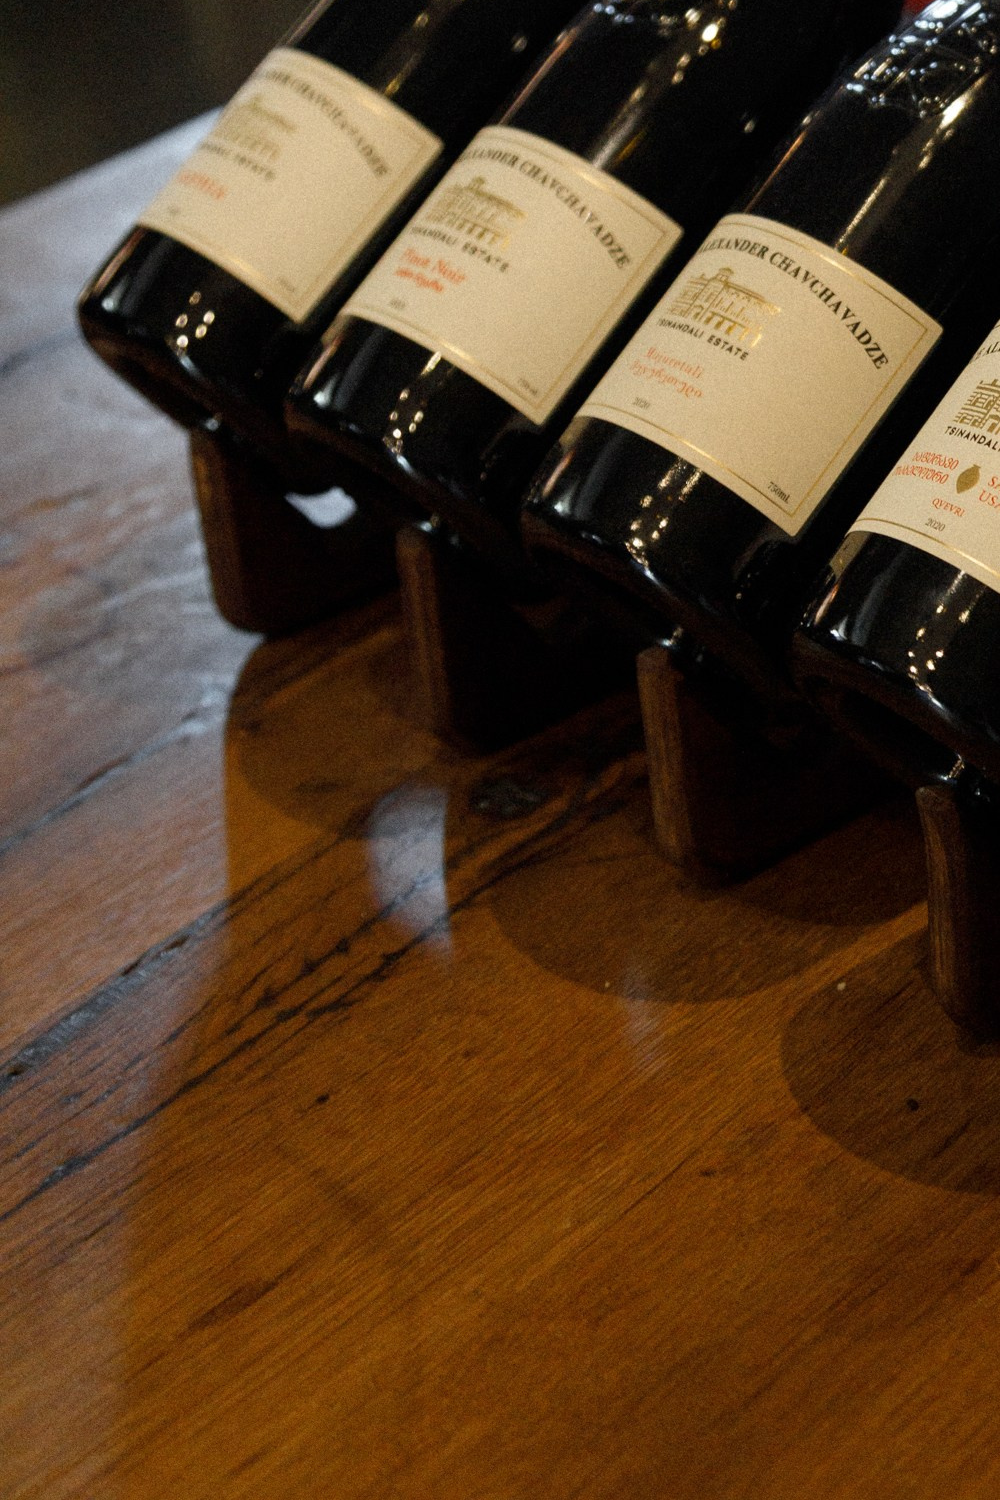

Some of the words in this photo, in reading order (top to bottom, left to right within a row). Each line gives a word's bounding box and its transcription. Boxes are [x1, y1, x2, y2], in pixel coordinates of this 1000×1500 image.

[520, 158, 630, 269] CHAVCHAVADZE
[769, 251, 889, 370] CHAVCHAVADZE
[707, 335, 749, 361] ESTATE
[932, 498, 966, 517] QVEVRI
[925, 517, 946, 532] 2020
